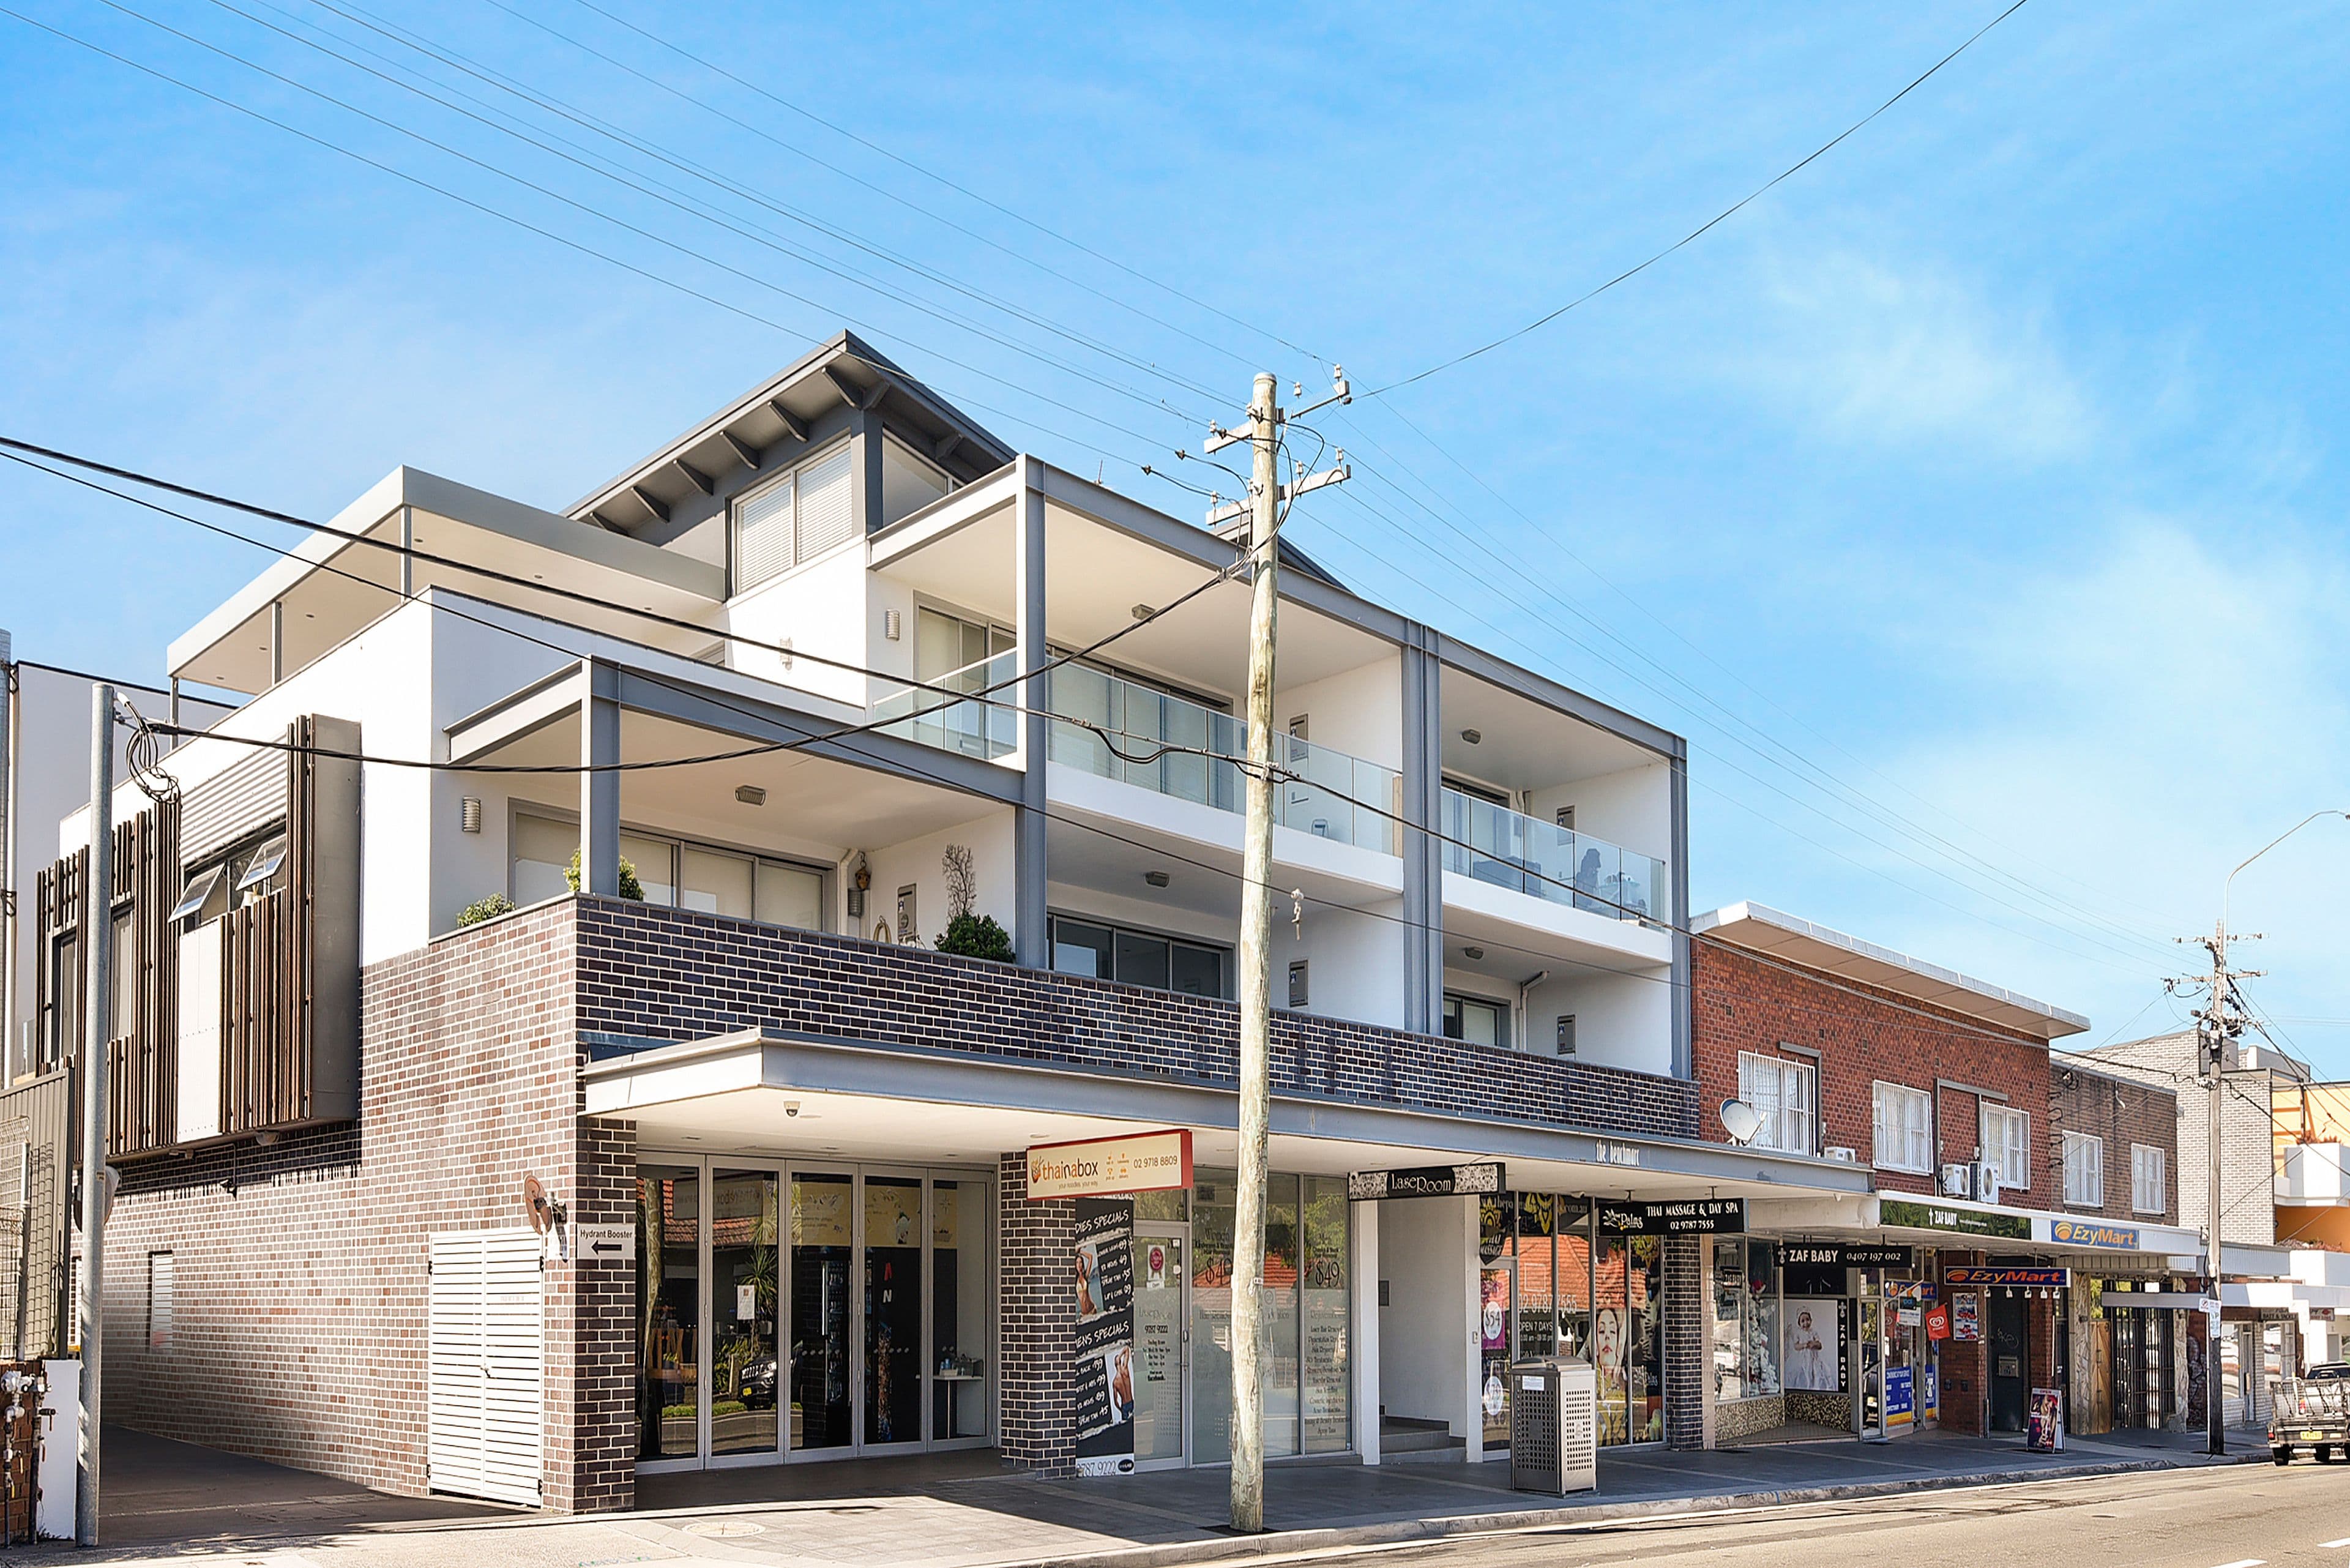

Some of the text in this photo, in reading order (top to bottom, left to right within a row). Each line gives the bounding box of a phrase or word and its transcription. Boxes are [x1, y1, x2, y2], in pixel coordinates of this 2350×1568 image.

[1133, 1159, 1142, 1168] 02
[1143, 1157, 1158, 1168] 9718
[1160, 1155, 1178, 1166] 8809
[1043, 1158, 1098, 1181] thainabox
[1646, 1202, 1739, 1217] THAI MASSAGE & DAY SPA
[1094, 1209, 1128, 1230] SPECIALS
[1670, 1220, 1714, 1230] 02 9787 7555
[580, 1230, 632, 1239] Hydrant Booster
[2072, 1225, 2135, 1247] EzyMart
[1789, 1249, 1838, 1263] ZAF BABY
[1846, 1252, 1901, 1261] 0407 197 002
[1316, 1261, 1340, 1287] $49
[1970, 1270, 2061, 1283] EzyMart
[1094, 1321, 1128, 1342] SPECIALS
[1519, 1321, 1553, 1332] OPEN 7 DAYS
